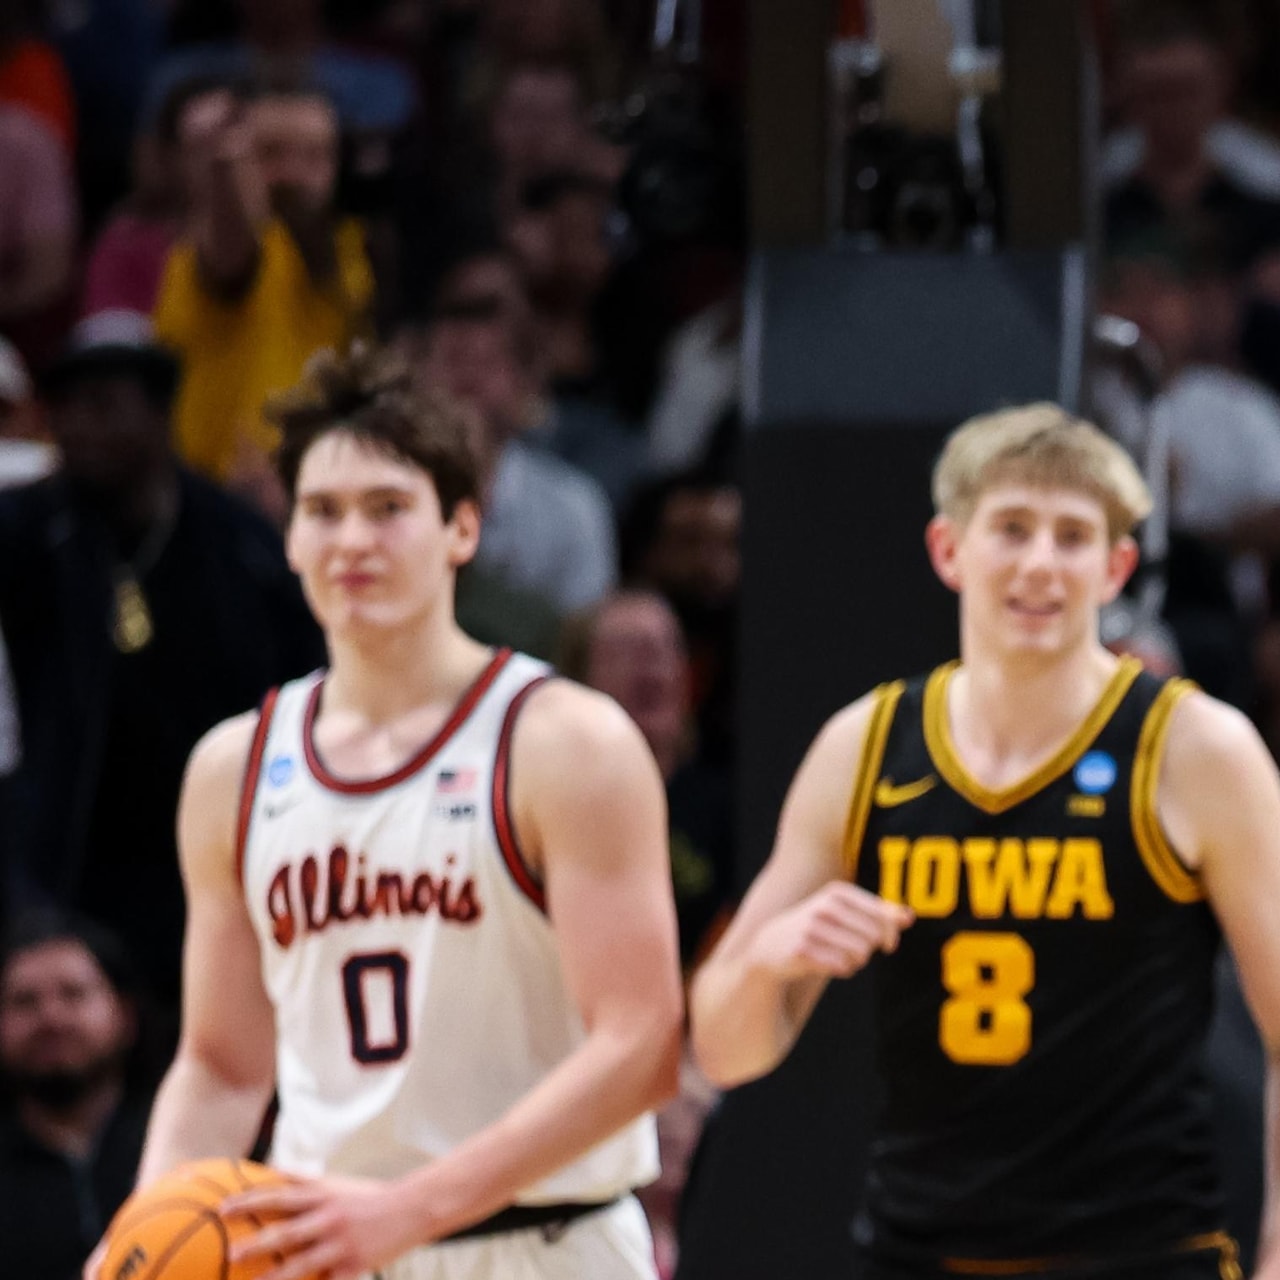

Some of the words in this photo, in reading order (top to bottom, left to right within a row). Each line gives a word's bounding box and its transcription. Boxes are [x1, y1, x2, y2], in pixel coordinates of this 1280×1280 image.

[268, 843, 483, 949] Illinois
[878, 836, 1116, 921] IOWA
[341, 952, 410, 1065] 0
[938, 930, 1035, 1067] 8
